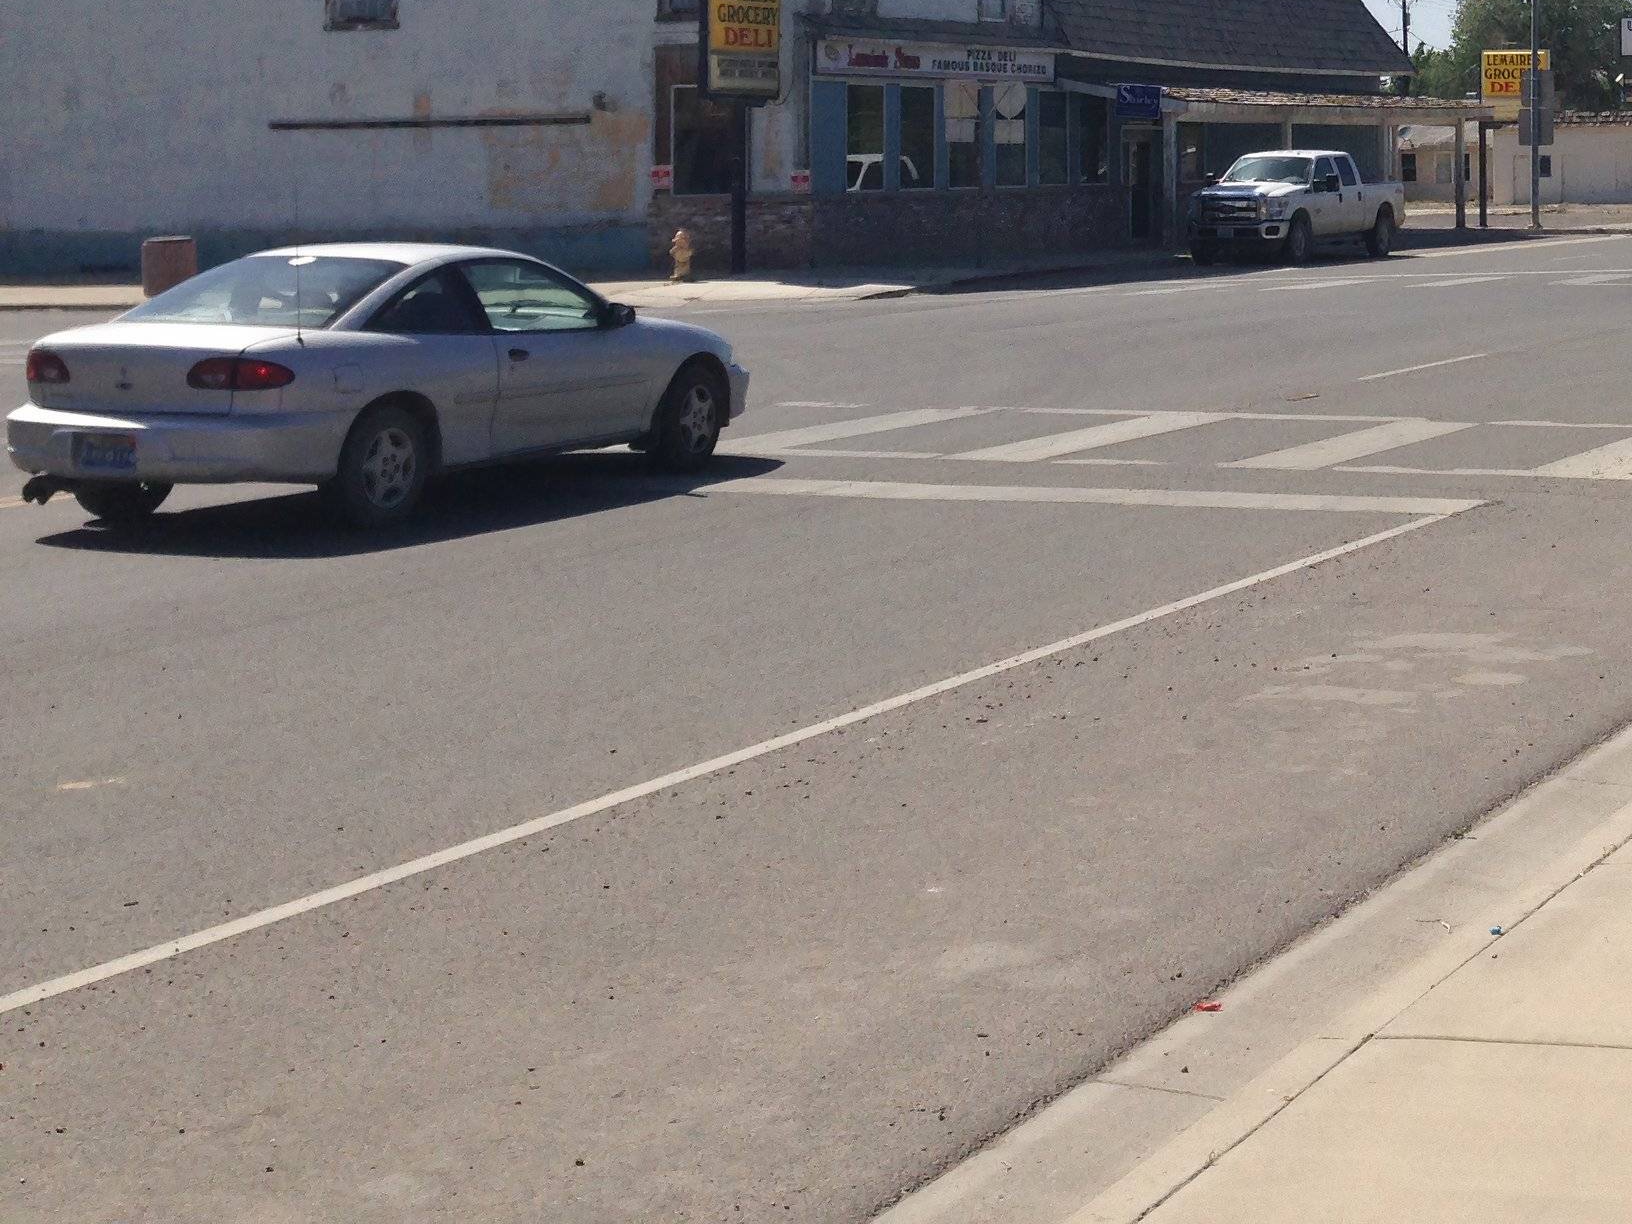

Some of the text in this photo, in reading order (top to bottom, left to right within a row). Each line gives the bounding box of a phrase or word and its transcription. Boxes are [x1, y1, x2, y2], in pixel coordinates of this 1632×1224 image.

[717, 3, 778, 26] GROCERY
[724, 26, 773, 48] DELI
[931, 59, 970, 72] FAMOUS
[1484, 67, 1526, 80] GROC
